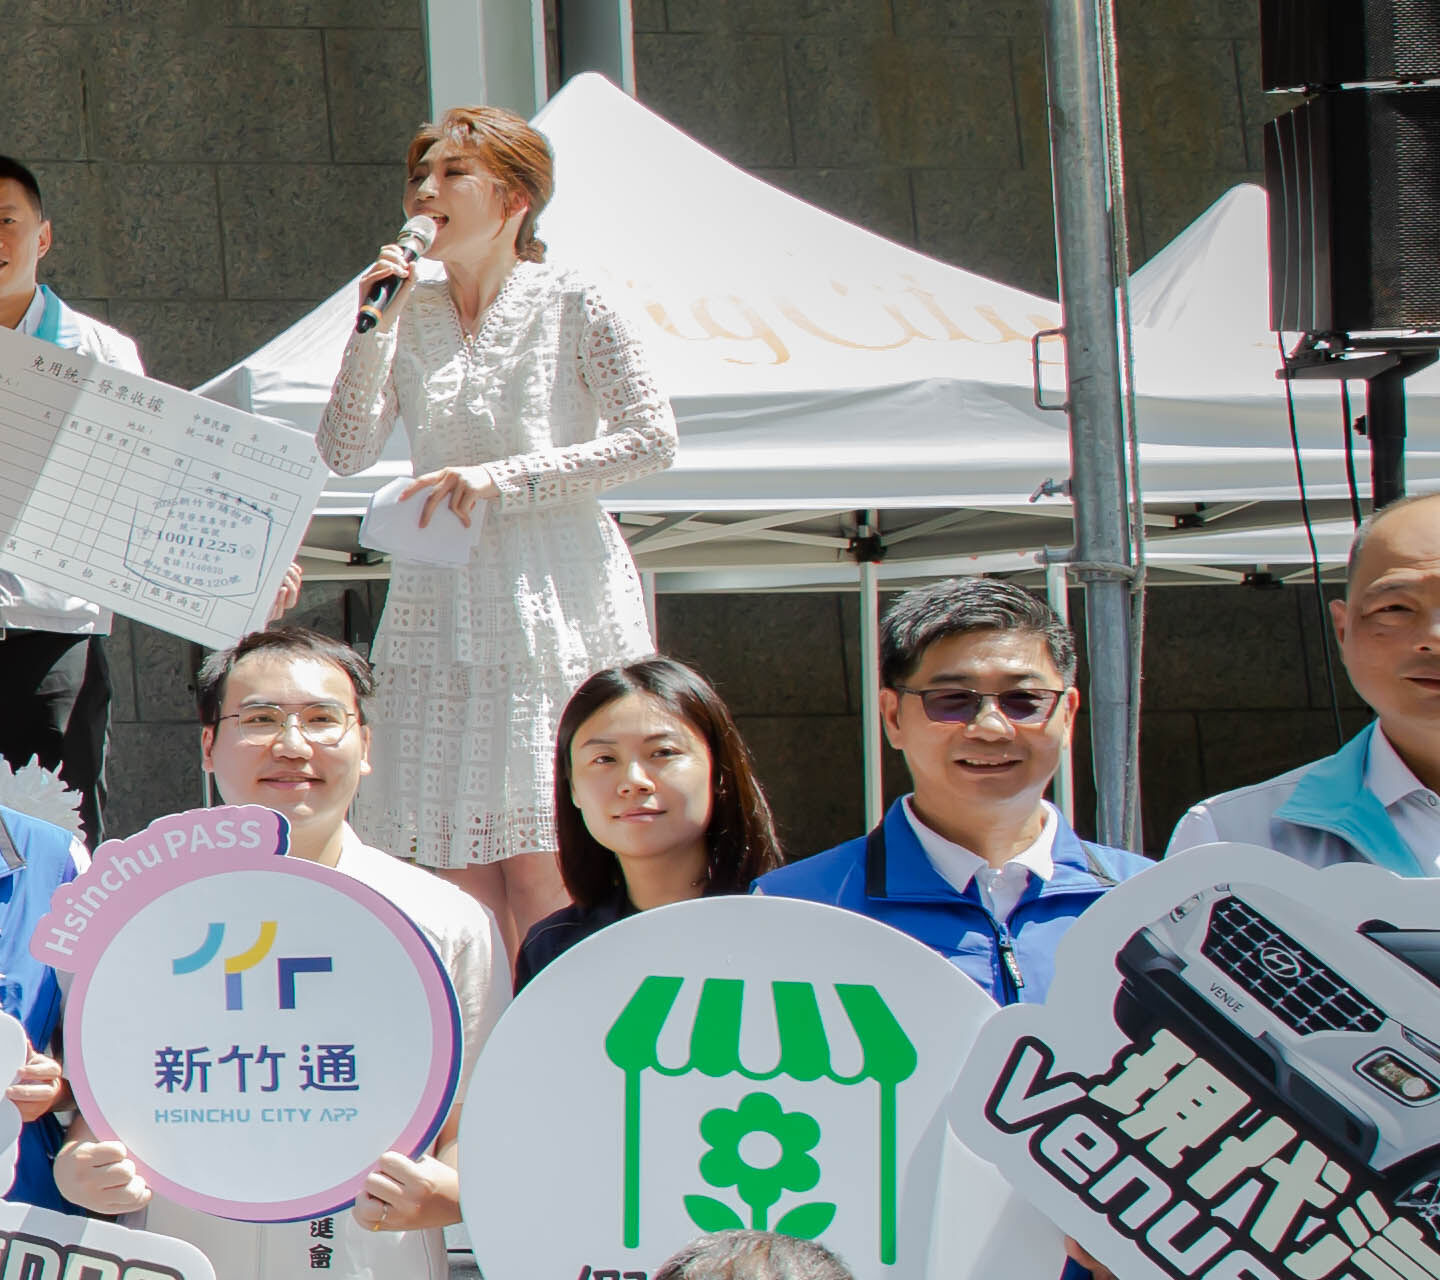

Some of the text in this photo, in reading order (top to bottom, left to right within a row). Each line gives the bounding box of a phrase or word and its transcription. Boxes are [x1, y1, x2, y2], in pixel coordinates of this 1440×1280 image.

[155, 530, 238, 555] 10011225
[44, 820, 261, 956] Hsinchu PASS
[1208, 981, 1245, 1014] VENUE
[154, 1043, 359, 1094] 新竹通
[155, 1108, 358, 1123] HSINCHU CITY APP
